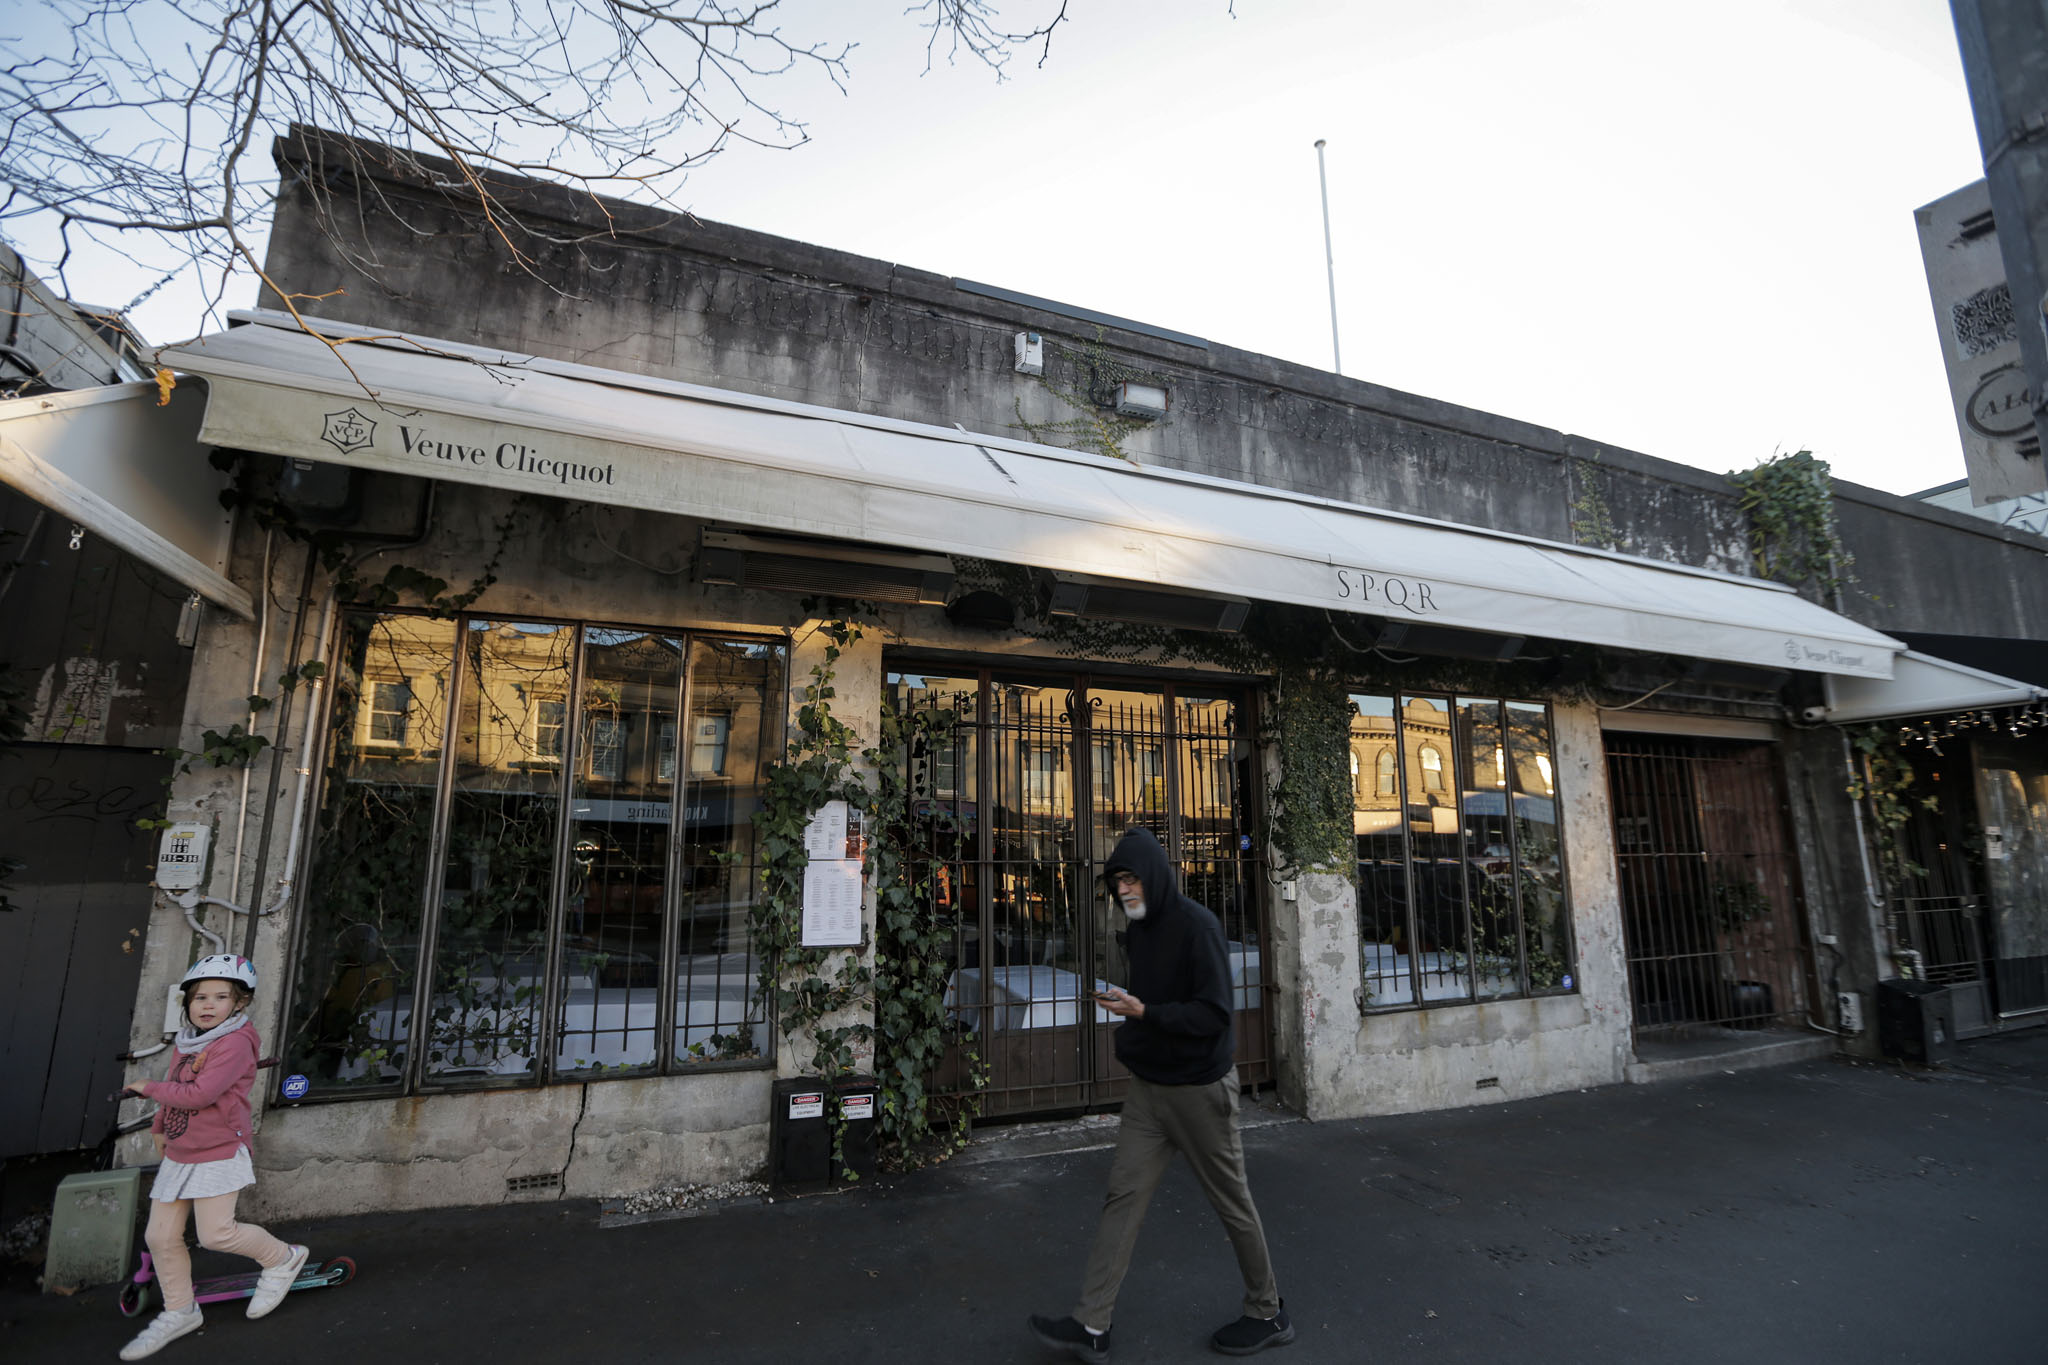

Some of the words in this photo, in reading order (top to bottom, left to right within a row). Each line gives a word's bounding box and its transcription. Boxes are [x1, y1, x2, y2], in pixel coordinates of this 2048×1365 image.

[396, 425, 486, 465] Veuve
[495, 442, 616, 486] Clicquot
[286, 1082, 305, 1091] ADT
